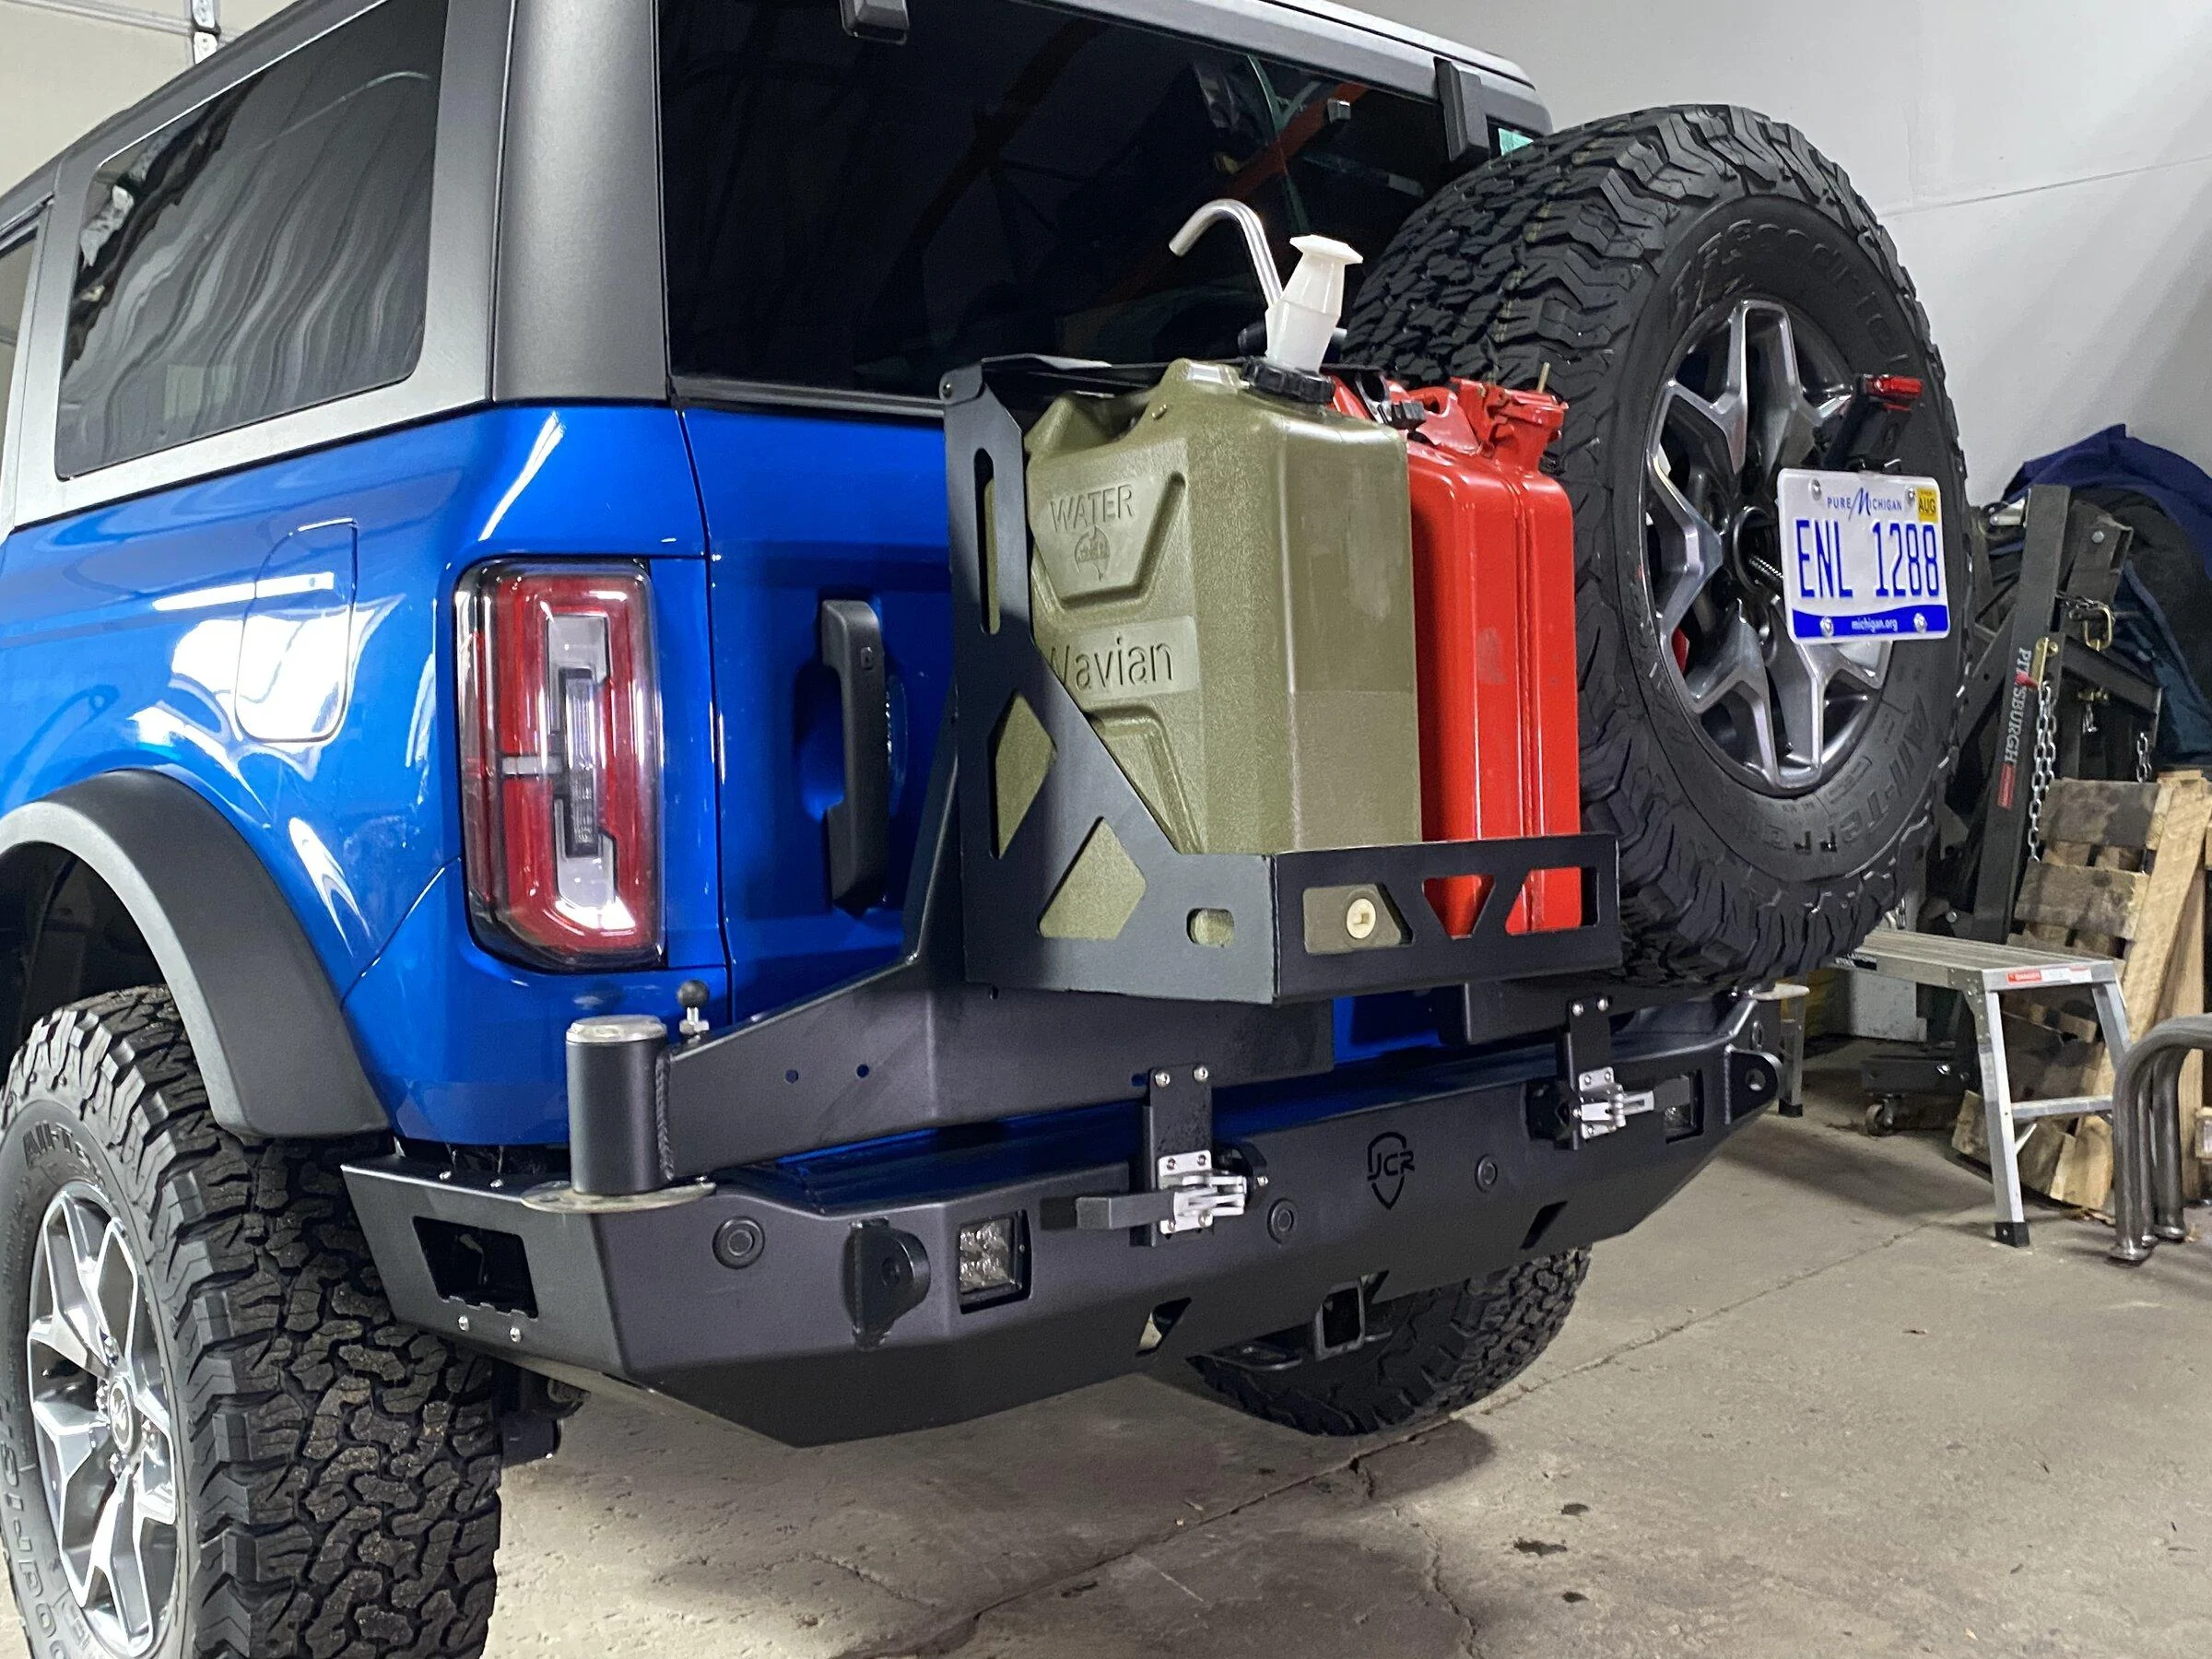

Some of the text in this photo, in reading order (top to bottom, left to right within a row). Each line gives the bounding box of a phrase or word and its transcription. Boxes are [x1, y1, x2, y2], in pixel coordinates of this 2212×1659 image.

[1050, 484, 1133, 532] WATER
[1827, 486, 1902, 521] PURE MICHIGAN
[1918, 498, 1936, 513] AUG
[1795, 519, 1940, 598] ENL 1288
[1851, 617, 1898, 633] michigan.org
[2004, 647, 2032, 765] PITSBURGH
[1367, 1150, 1416, 1182] JCR
